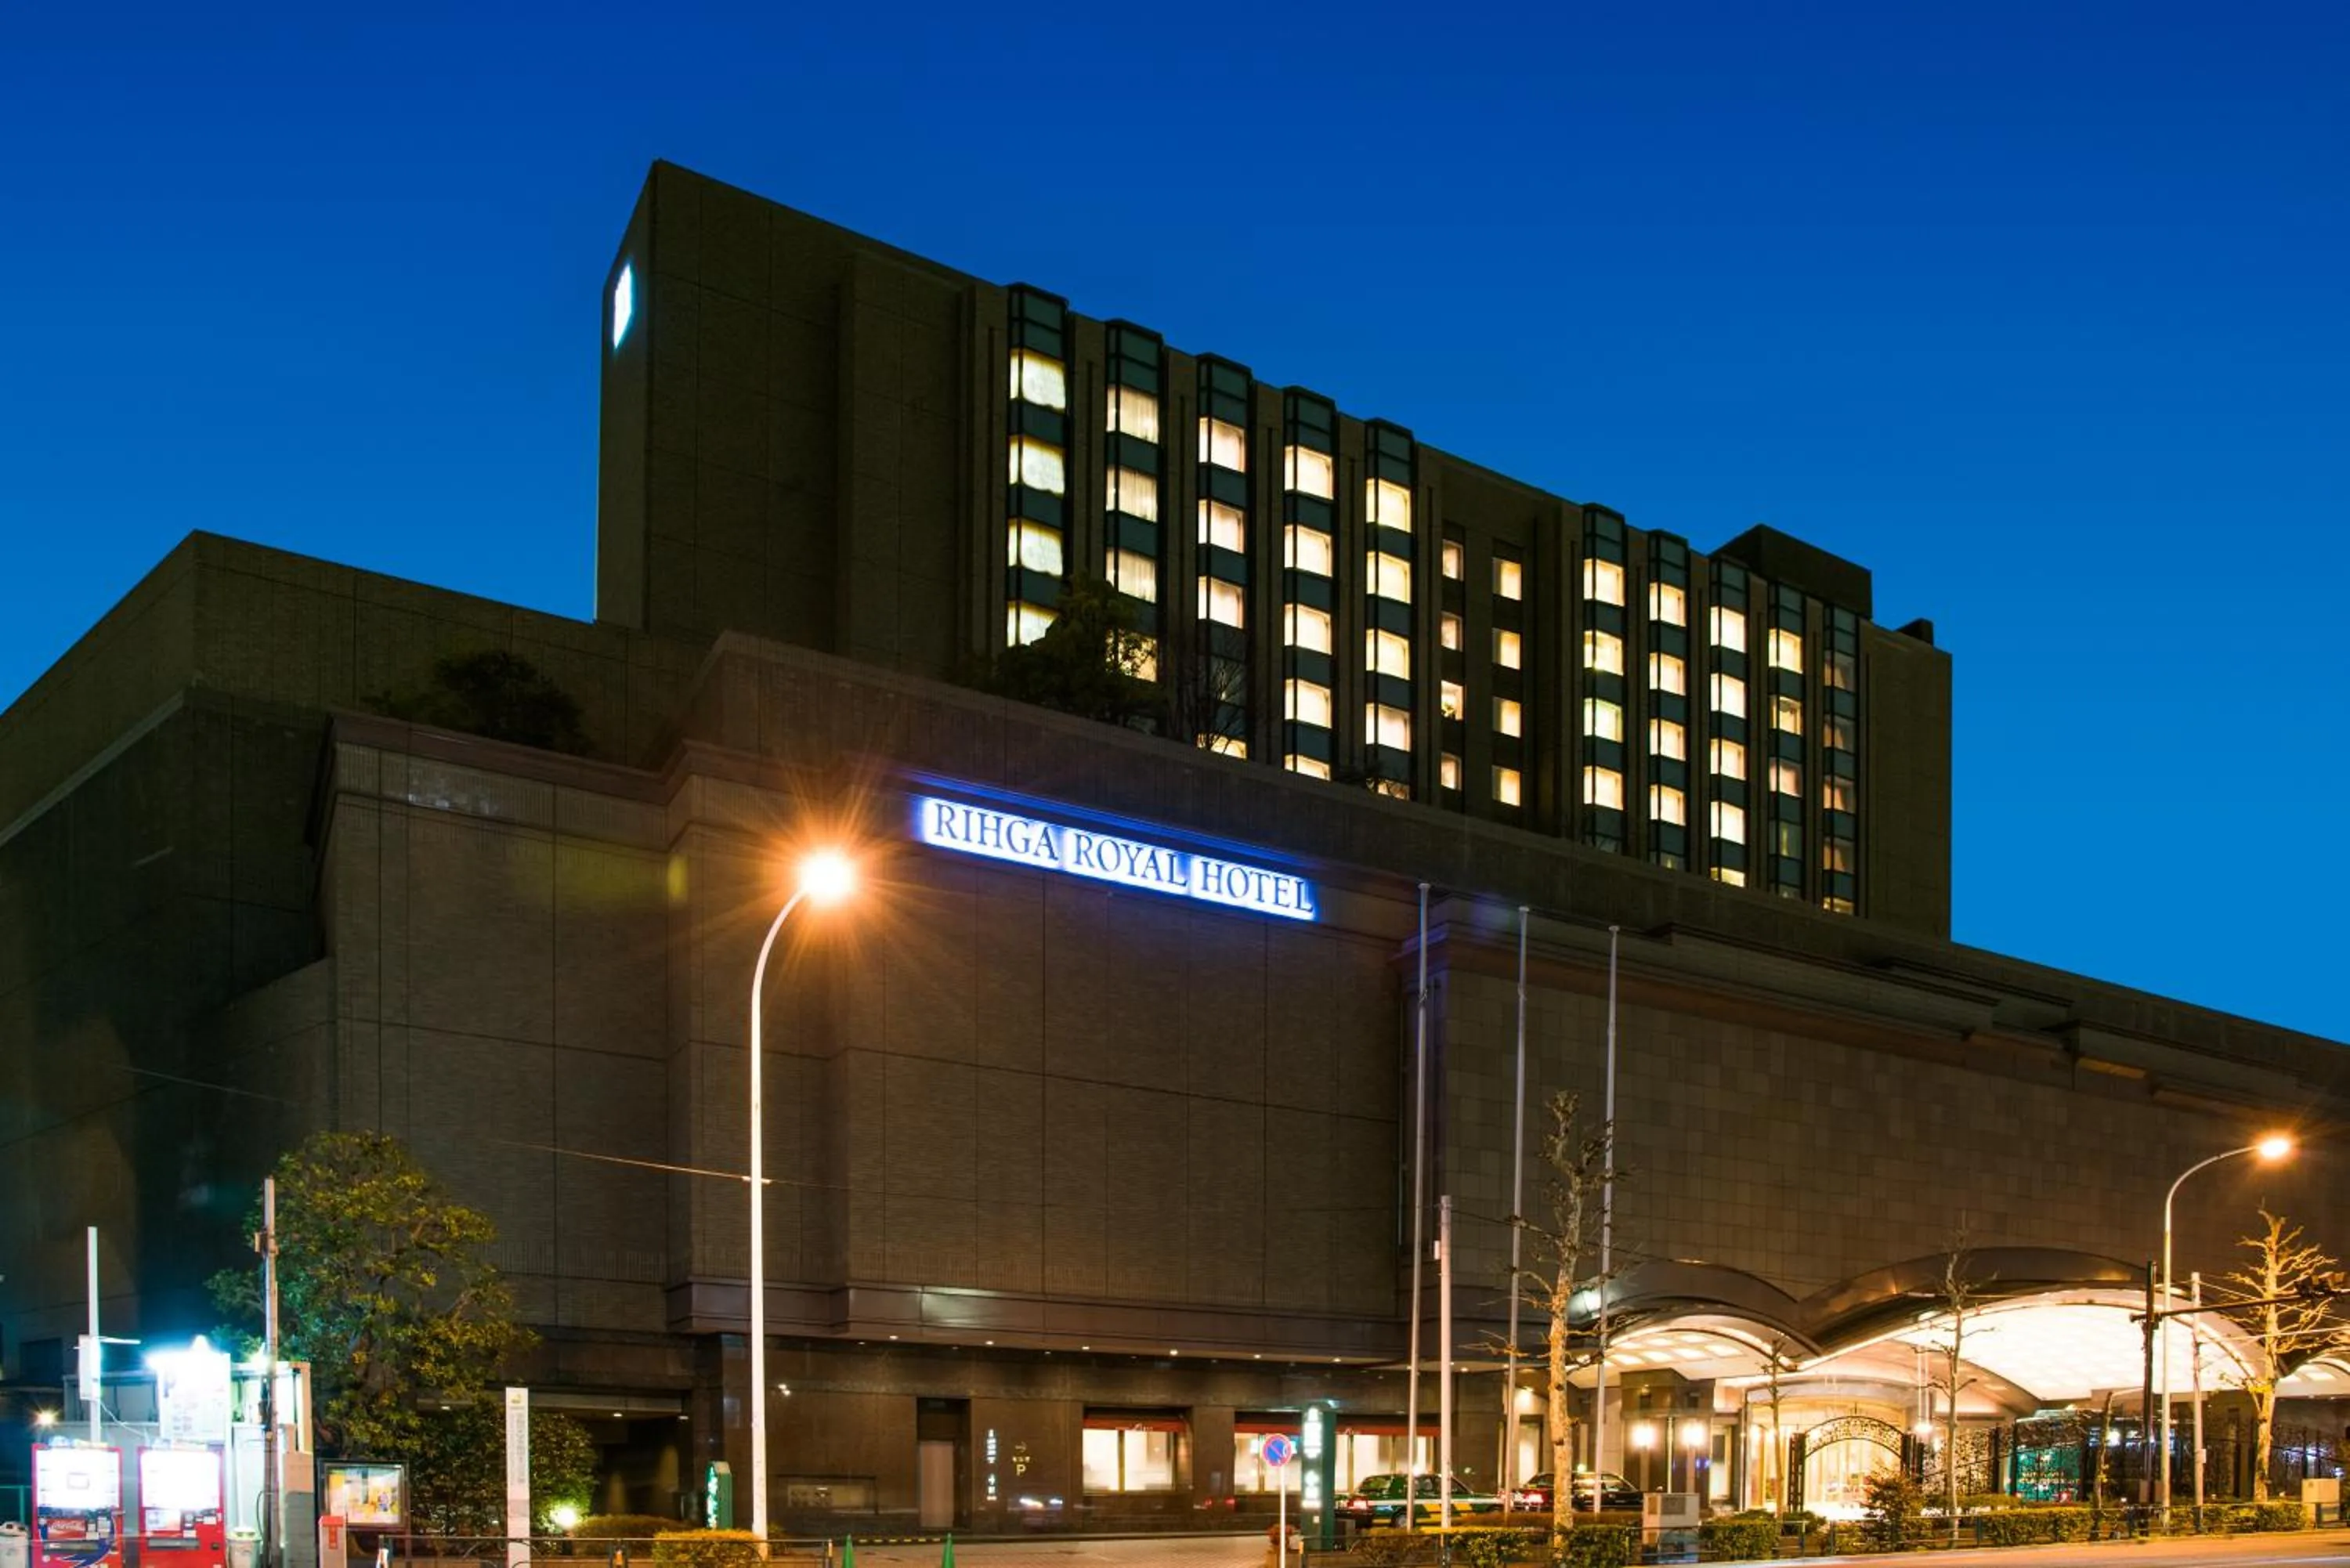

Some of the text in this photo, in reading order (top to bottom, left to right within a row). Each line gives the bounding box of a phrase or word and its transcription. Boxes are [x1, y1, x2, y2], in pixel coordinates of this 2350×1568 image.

[934, 802, 1314, 912] RIHGA ROYAL HOTEL
[1016, 1464, 1026, 1476] P
